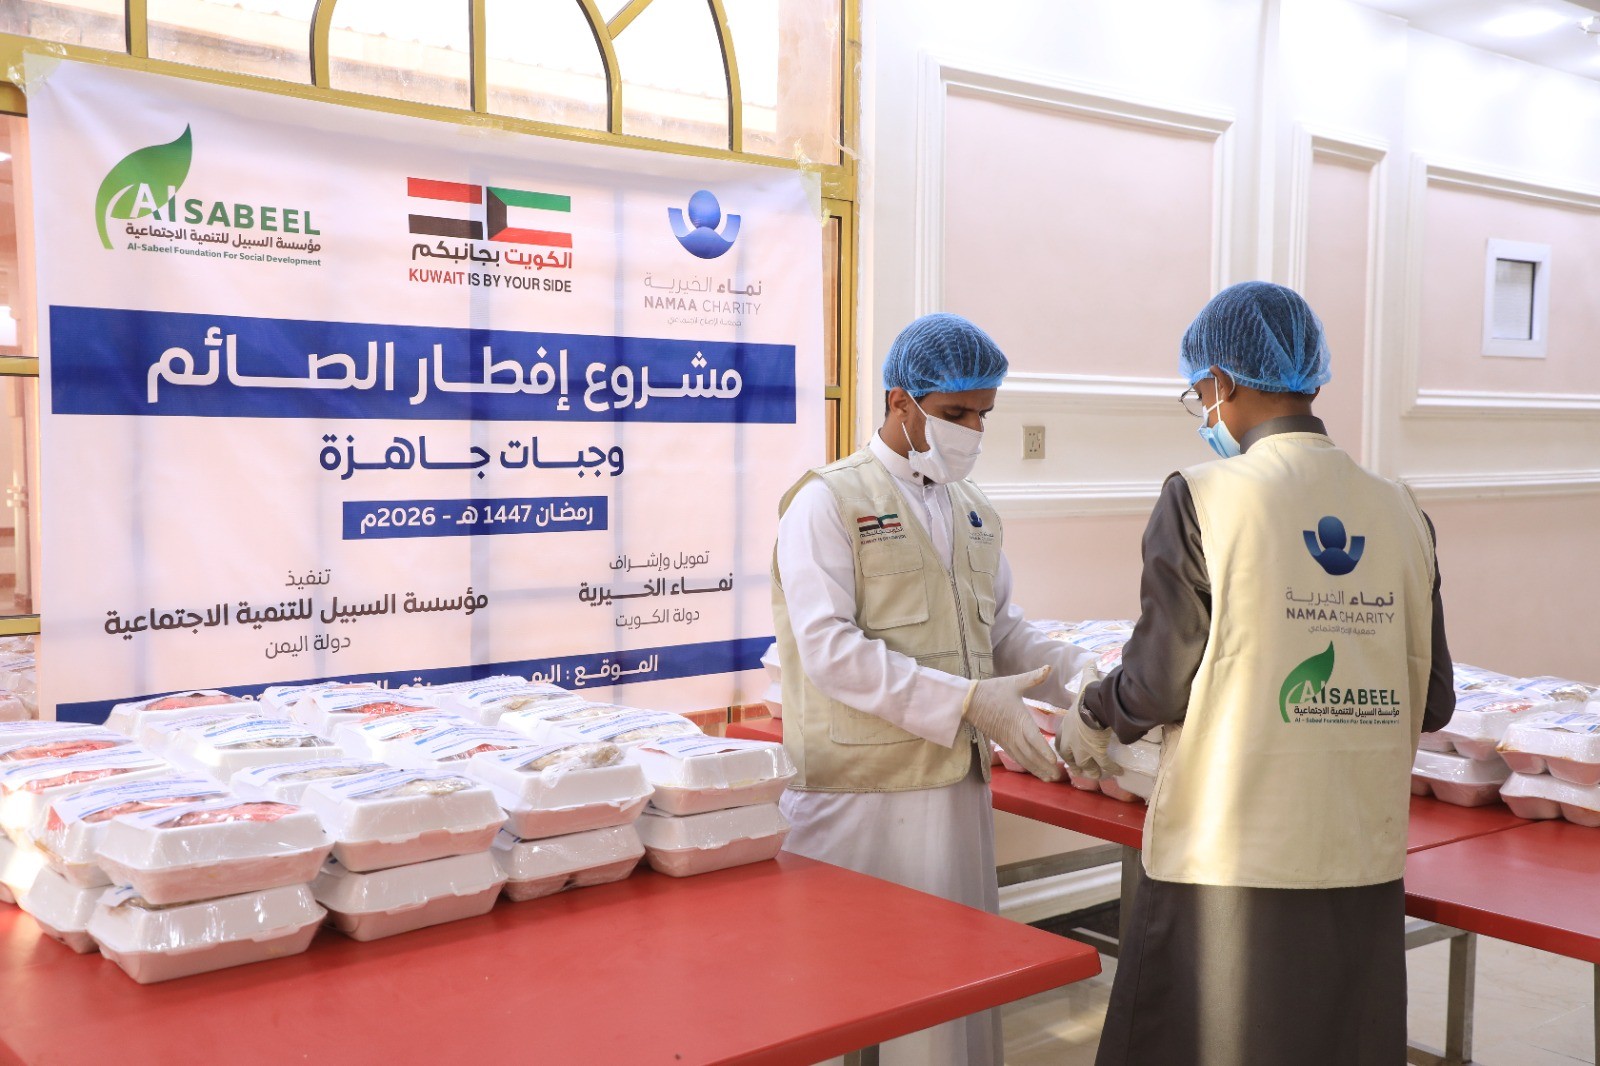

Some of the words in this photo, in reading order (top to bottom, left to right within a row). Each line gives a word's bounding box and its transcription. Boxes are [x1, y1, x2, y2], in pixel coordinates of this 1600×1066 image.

[125, 222, 186, 240] الاجتماعية
[190, 229, 229, 245] للتنمية
[232, 234, 272, 249] السبيل
[127, 243, 172, 254] Al-Sabeel
[174, 246, 222, 259] Foundation
[224, 251, 237, 260] For
[239, 252, 265, 262] Social
[266, 254, 321, 266] Development
[276, 236, 321, 253] مؤسسة
[412, 240, 500, 267] بجانبكم
[504, 248, 572, 270] الكويت
[409, 268, 465, 285] KUWAIT
[468, 272, 480, 286] IS
[483, 274, 501, 287] BY
[504, 275, 540, 291] YOUR
[543, 279, 572, 293] SIDE
[644, 272, 712, 294] الخيرية
[717, 278, 762, 296] نماء
[644, 295, 697, 312] NAMAA
[702, 299, 762, 315] CHARITY
[147, 326, 394, 404] الصائم
[409, 342, 569, 411] إفطار
[583, 351, 743, 412] مشروع
[319, 434, 491, 480] جاهزة
[500, 436, 625, 479] وجبات
[360, 507, 436, 534] 2026م
[483, 504, 532, 524] 1447
[535, 501, 594, 526] رمضان
[610, 552, 670, 573] وإشراف
[674, 551, 710, 569] تمويل
[286, 568, 331, 590] تنفيذ
[670, 573, 733, 596] نماء
[403, 587, 489, 616] مؤسسة
[578, 577, 666, 606] الخيرية
[1285, 586, 1345, 606] الخيرية
[1349, 592, 1394, 607] نماء
[235, 598, 313, 630] للتنمية
[320, 593, 397, 624] السبيل
[615, 609, 669, 630] الكويت
[673, 608, 700, 625] دولة
[1286, 608, 1338, 621] NAMAA
[1339, 611, 1395, 624] CHARITY
[104, 603, 228, 640] الاجتماعية
[265, 636, 308, 659] اليمن
[314, 634, 351, 654] دولة
[531, 664, 561, 683] اليم
[574, 654, 658, 686] الموقع
[1294, 705, 1329, 717] الاجتماعية
[1331, 706, 1354, 717] للتنمية
[1355, 707, 1377, 718] السبيل
